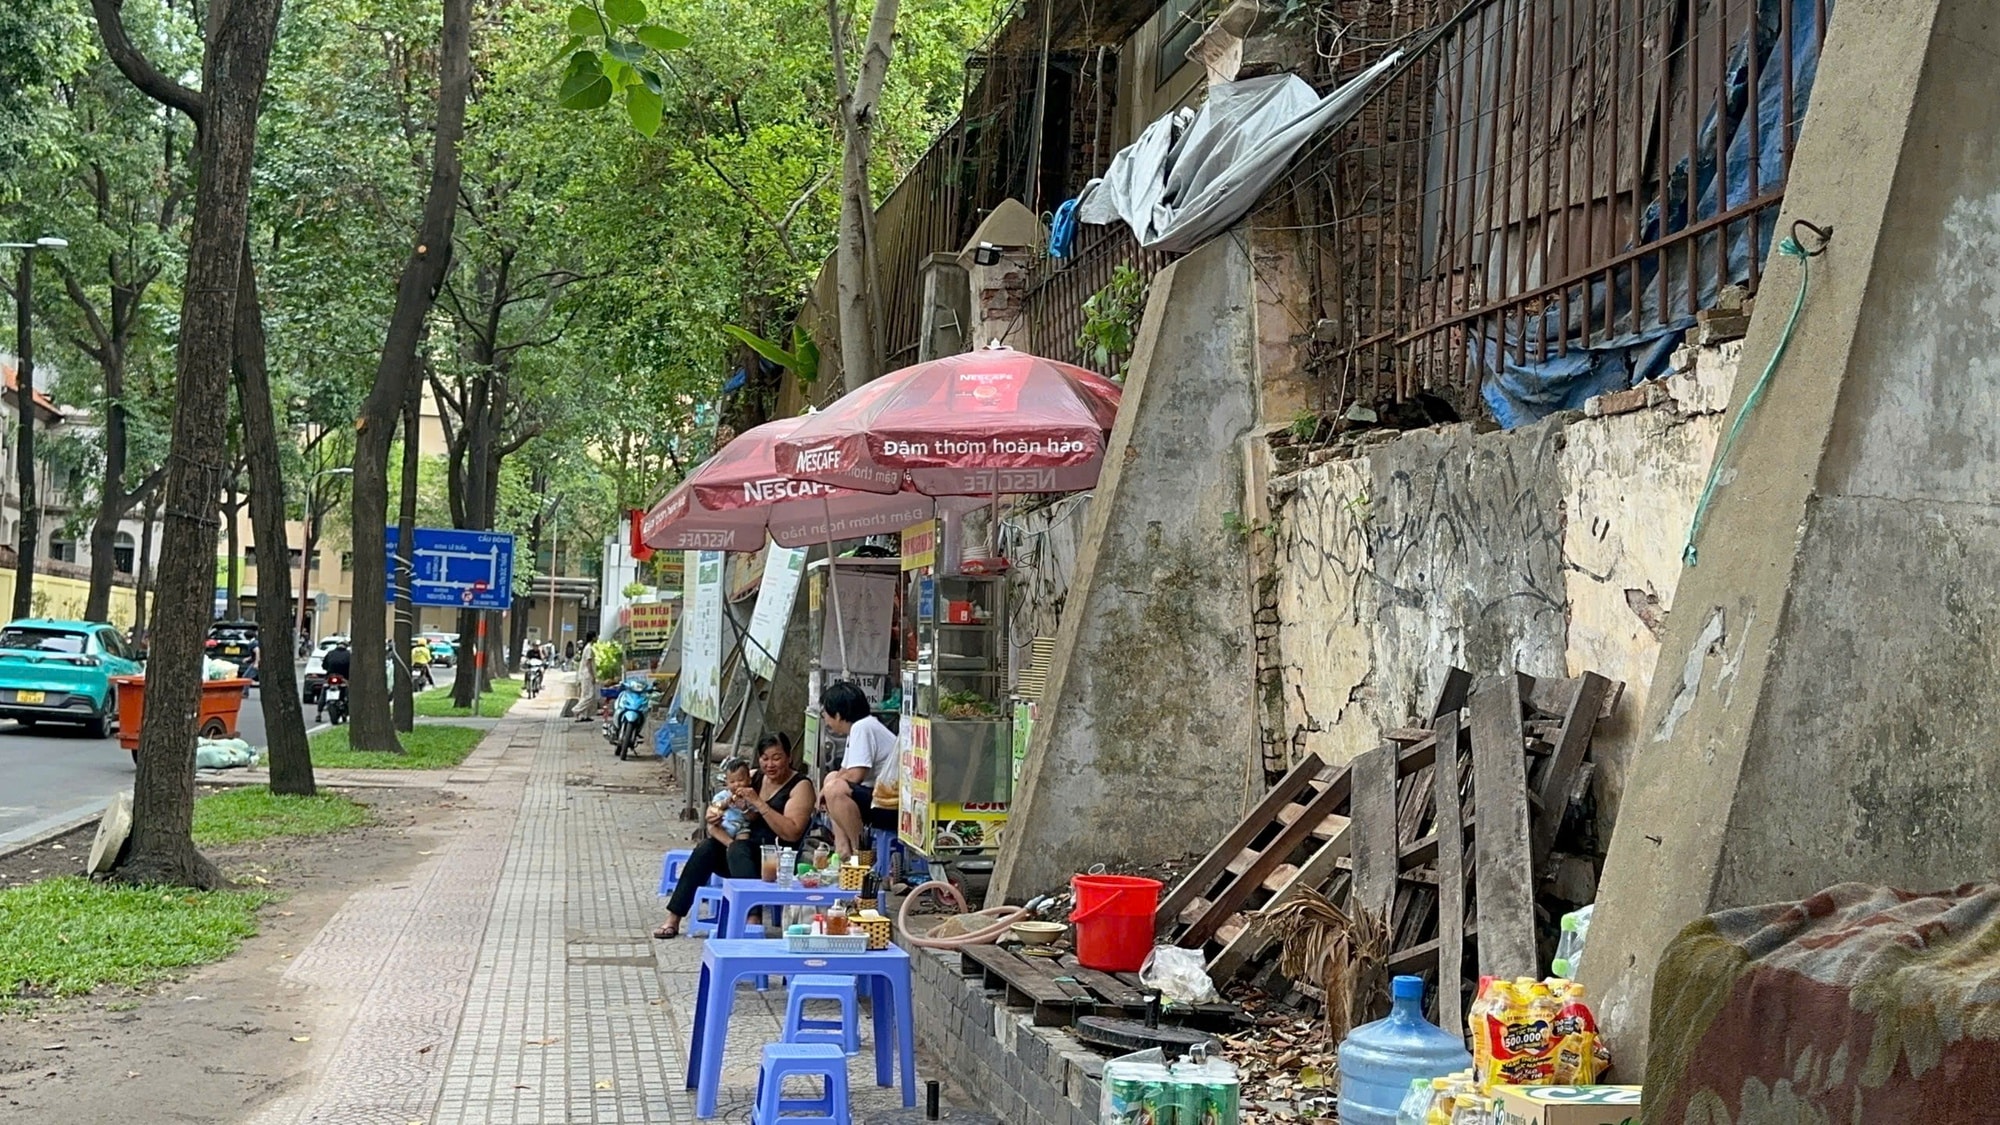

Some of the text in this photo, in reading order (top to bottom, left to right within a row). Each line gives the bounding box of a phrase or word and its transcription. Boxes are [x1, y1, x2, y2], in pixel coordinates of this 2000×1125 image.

[883, 435, 1083, 457] Đậm thơm hoàn hảo
[1505, 1032, 1541, 1048] 500.000
